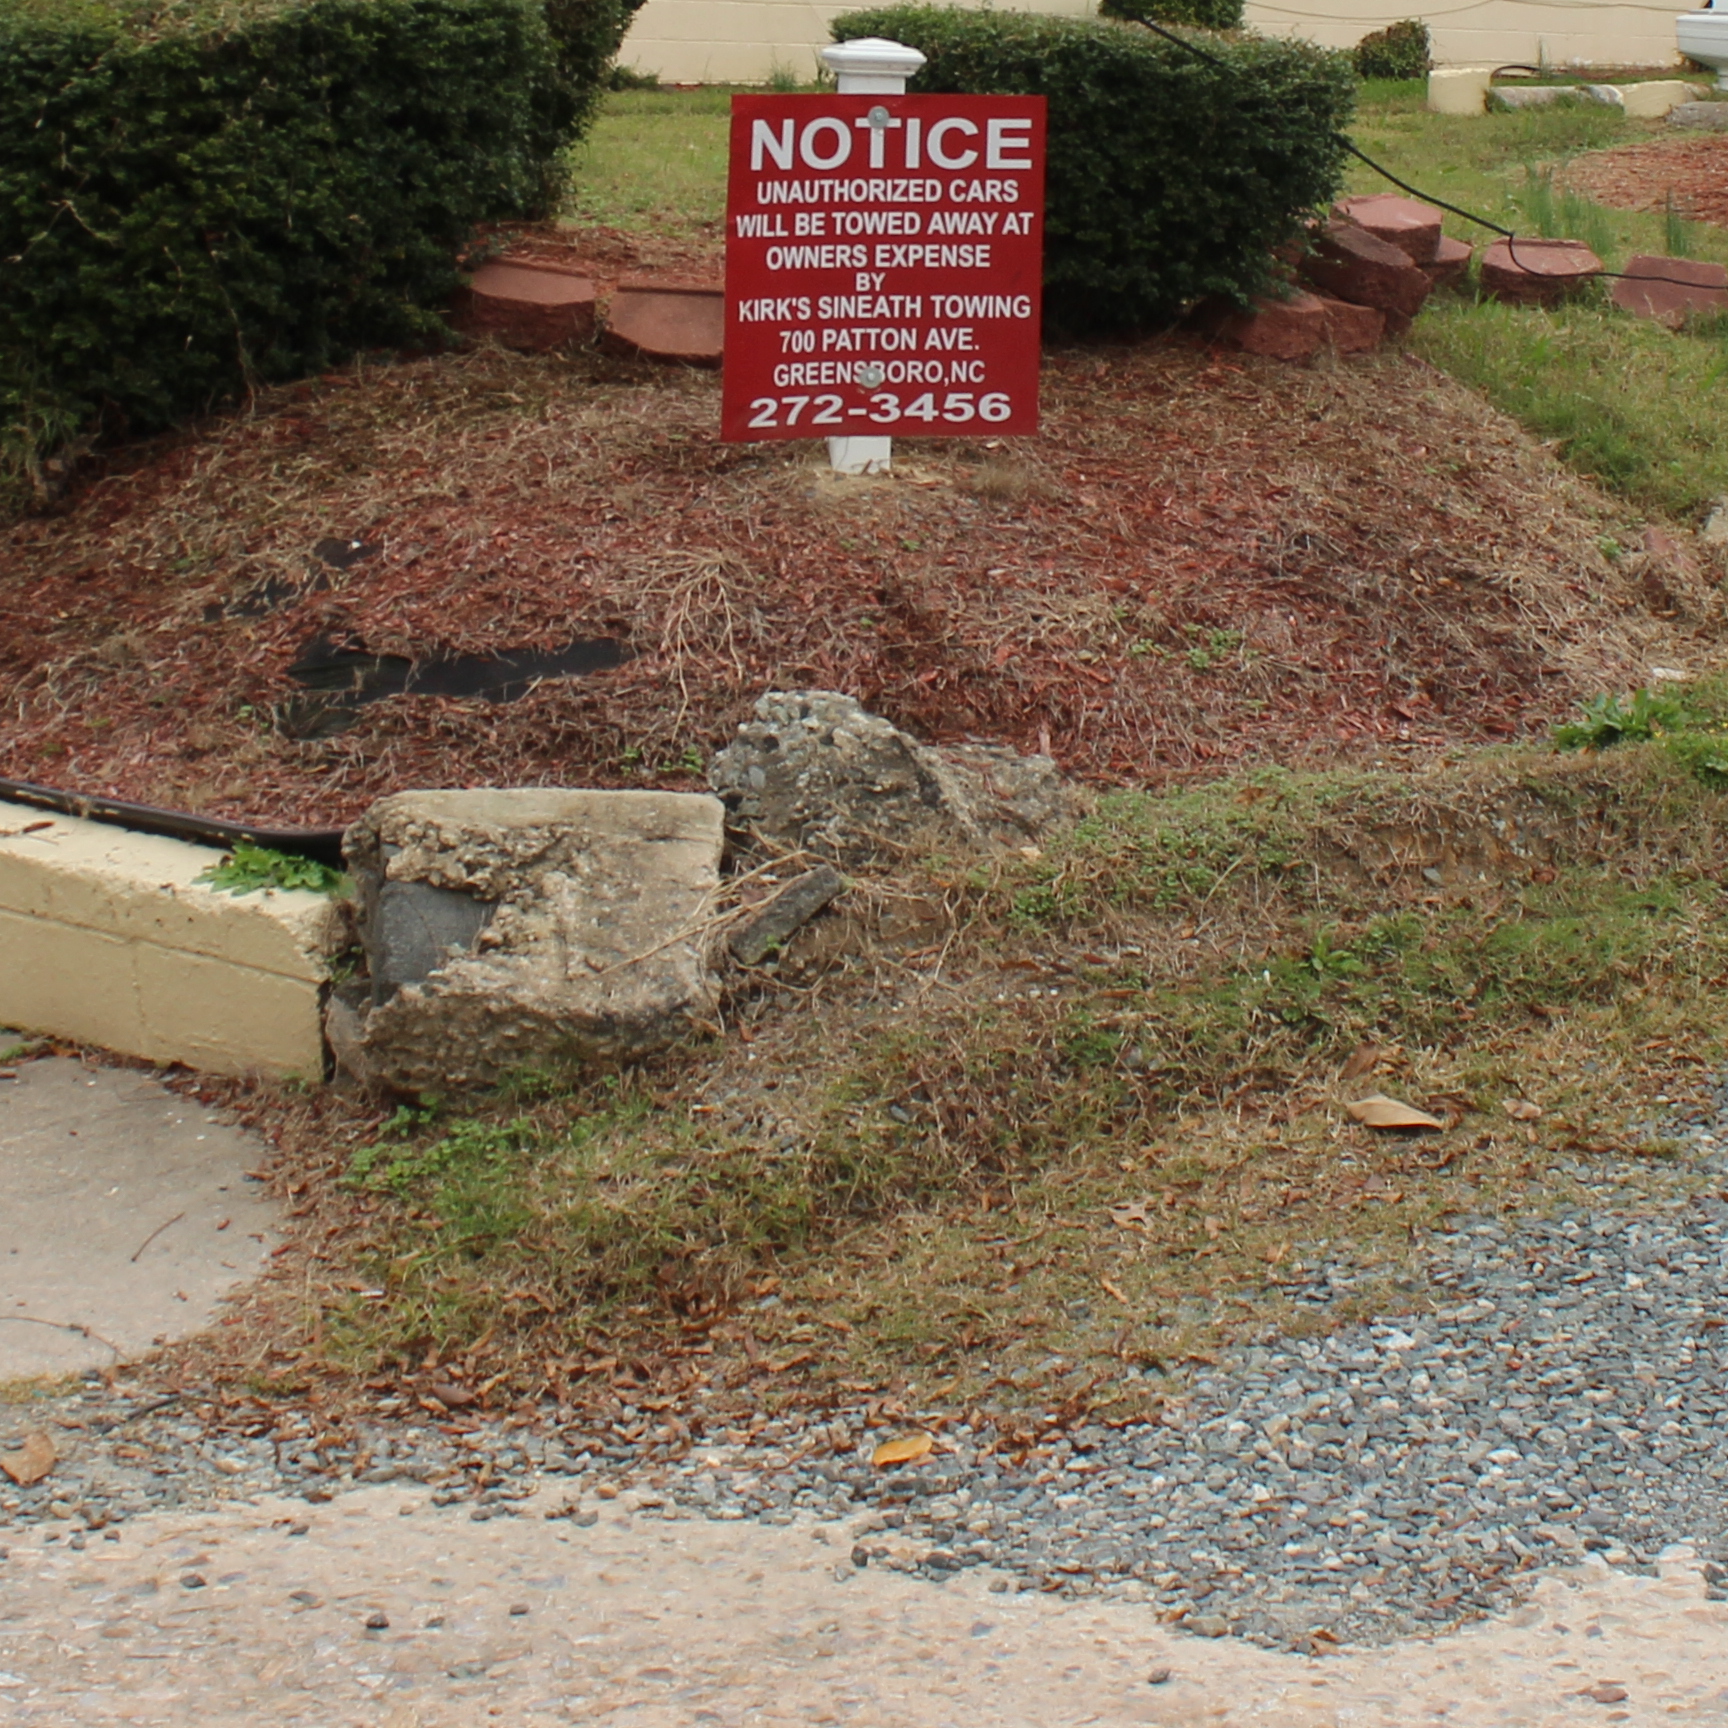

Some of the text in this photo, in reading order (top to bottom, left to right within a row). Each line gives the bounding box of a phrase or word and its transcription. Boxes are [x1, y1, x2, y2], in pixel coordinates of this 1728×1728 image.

[751, 117, 1032, 170] NOTICE
[757, 178, 1019, 204] UNAUTHORIZED CARS
[736, 212, 1034, 238] WILL BE TOWED AWAY AT
[766, 244, 991, 270] OWNERS EXPENSE
[855, 273, 886, 292] BY
[739, 295, 1031, 322] KIRK'S SINEATH TOWING
[780, 328, 980, 353] 700 PATTON AVE.
[748, 393, 1012, 428] 272-3456
